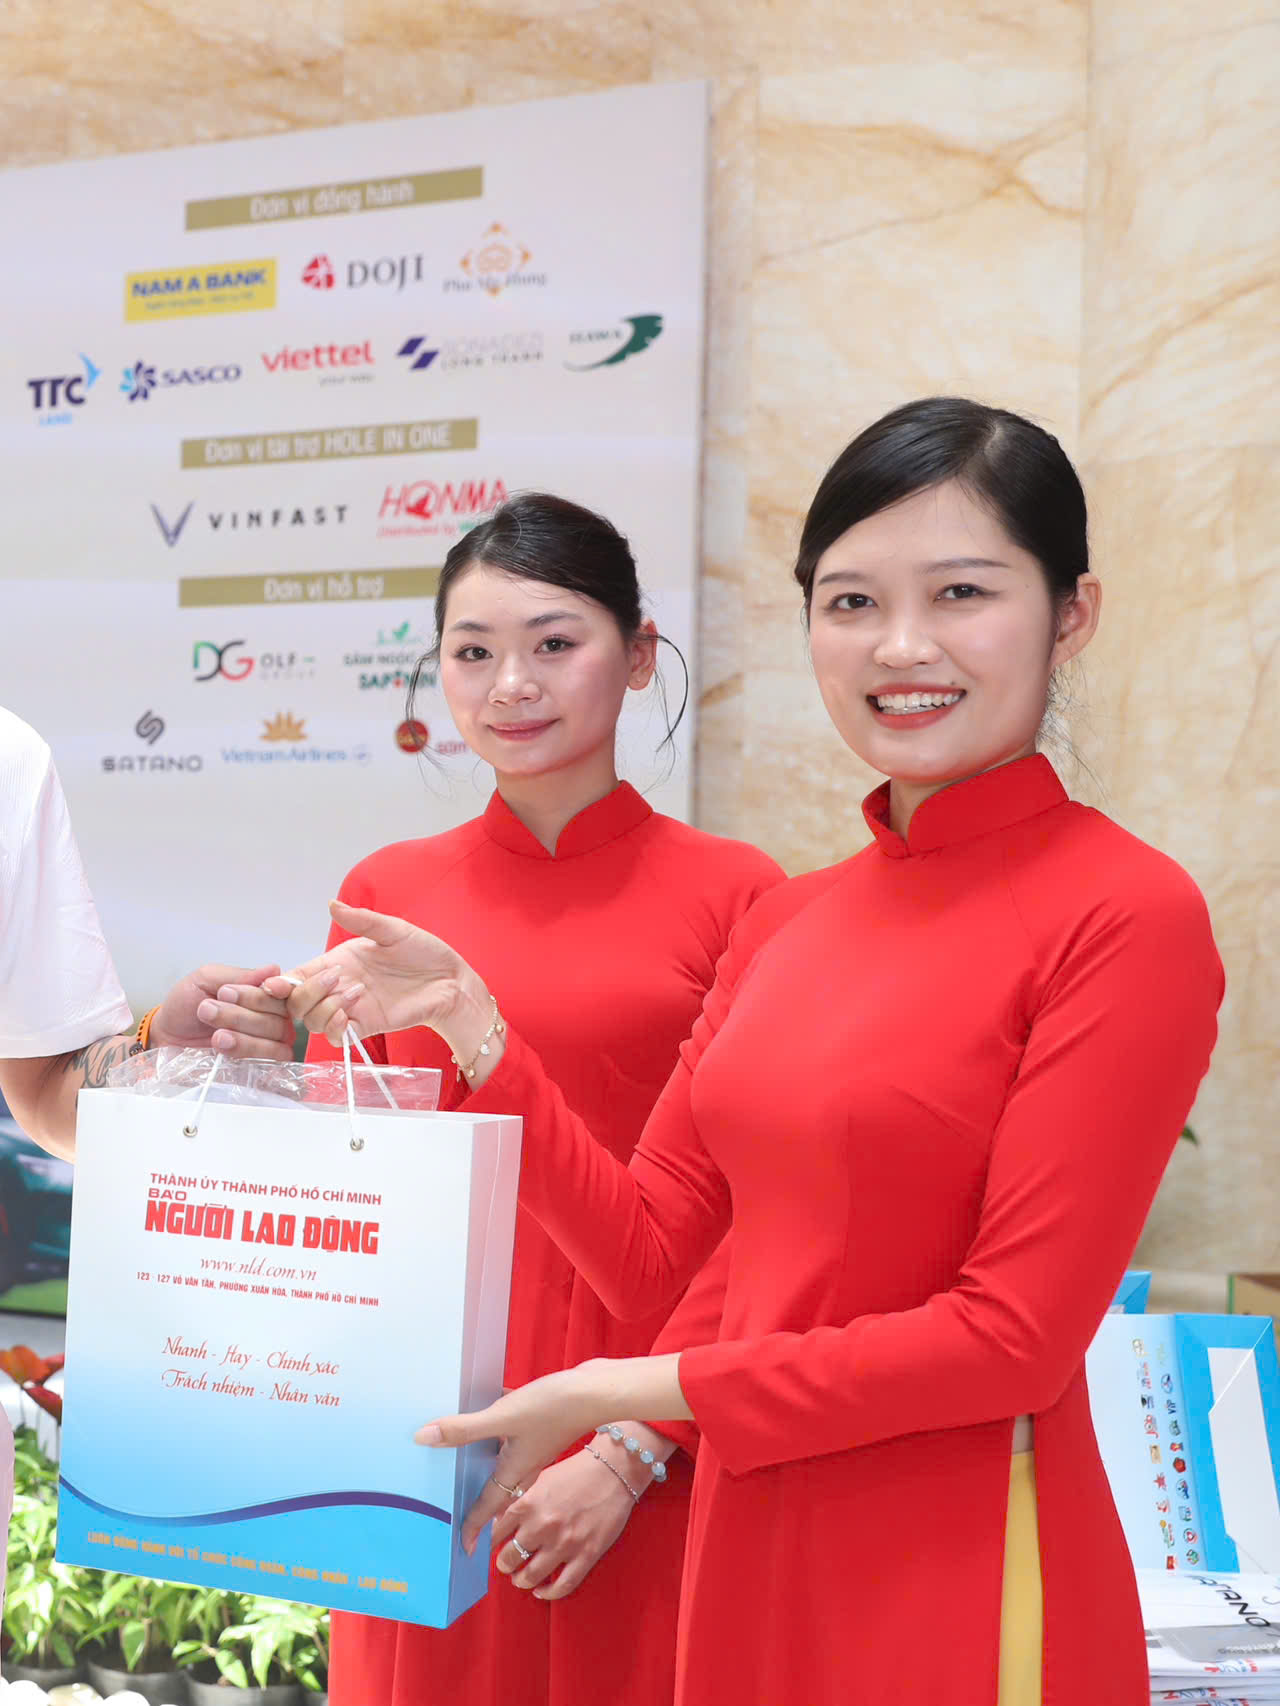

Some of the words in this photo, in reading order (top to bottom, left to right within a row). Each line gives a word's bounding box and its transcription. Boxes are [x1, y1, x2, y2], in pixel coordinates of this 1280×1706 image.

[132, 277, 183, 297] NAM
[187, 275, 201, 292] A
[205, 268, 267, 289] BANK
[346, 253, 424, 292] DOJI
[261, 339, 375, 372] viettel
[161, 364, 242, 387] SASCO
[27, 376, 86, 409] TTC
[324, 428, 376, 455] HOLE
[384, 426, 403, 450] IN
[409, 423, 452, 448] ONE
[378, 477, 509, 519] HONMA
[209, 505, 348, 530] VINFAST
[102, 755, 202, 772] SATANO
[150, 1172, 197, 1188] THÀNH
[222, 1180, 267, 1197] THÀNH
[271, 1184, 298, 1198] PHỐ
[322, 1188, 345, 1203] CHÍ
[346, 1191, 381, 1205] MINH
[145, 1199, 234, 1240] NGƯỜI
[241, 1210, 296, 1246] LAO
[303, 1215, 379, 1255] ĐỘNG
[200, 1255, 317, 1281] www.nld.com.vn
[137, 1272, 150, 1281] 123
[157, 1274, 170, 1283] 127
[359, 1296, 379, 1307] MINH
[161, 1335, 209, 1360] Nhanh
[219, 1343, 253, 1371] Hay
[266, 1351, 312, 1374] Chính
[310, 1358, 341, 1377] xác
[161, 1368, 208, 1391] Trách
[212, 1375, 255, 1398] nhiệm
[268, 1380, 309, 1404] Nhân
[314, 1391, 341, 1408] văn
